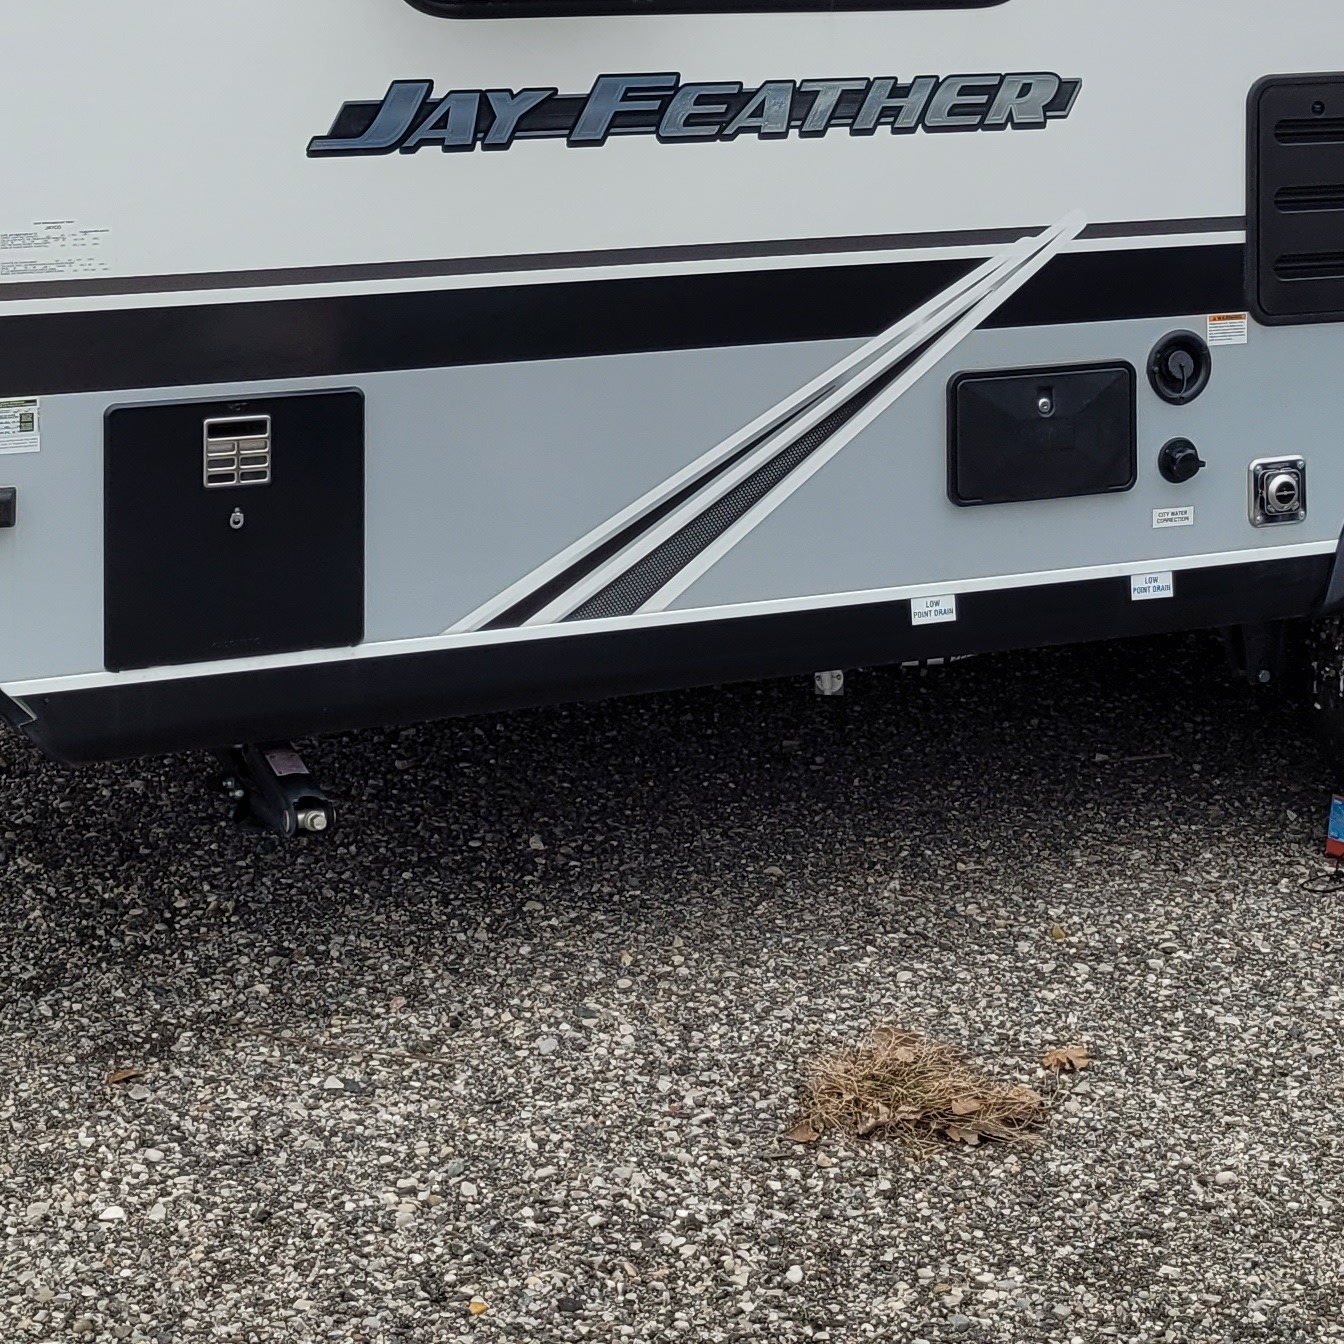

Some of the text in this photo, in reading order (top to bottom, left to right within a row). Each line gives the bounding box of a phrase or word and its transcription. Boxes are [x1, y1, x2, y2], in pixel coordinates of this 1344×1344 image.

[307, 71, 1062, 157] JAY FEATHER
[1144, 576, 1159, 584] LOW
[1132, 584, 1171, 594] POINT DRAIN
[925, 599, 941, 608] LOW
[913, 607, 954, 619] POINT DRAIN
